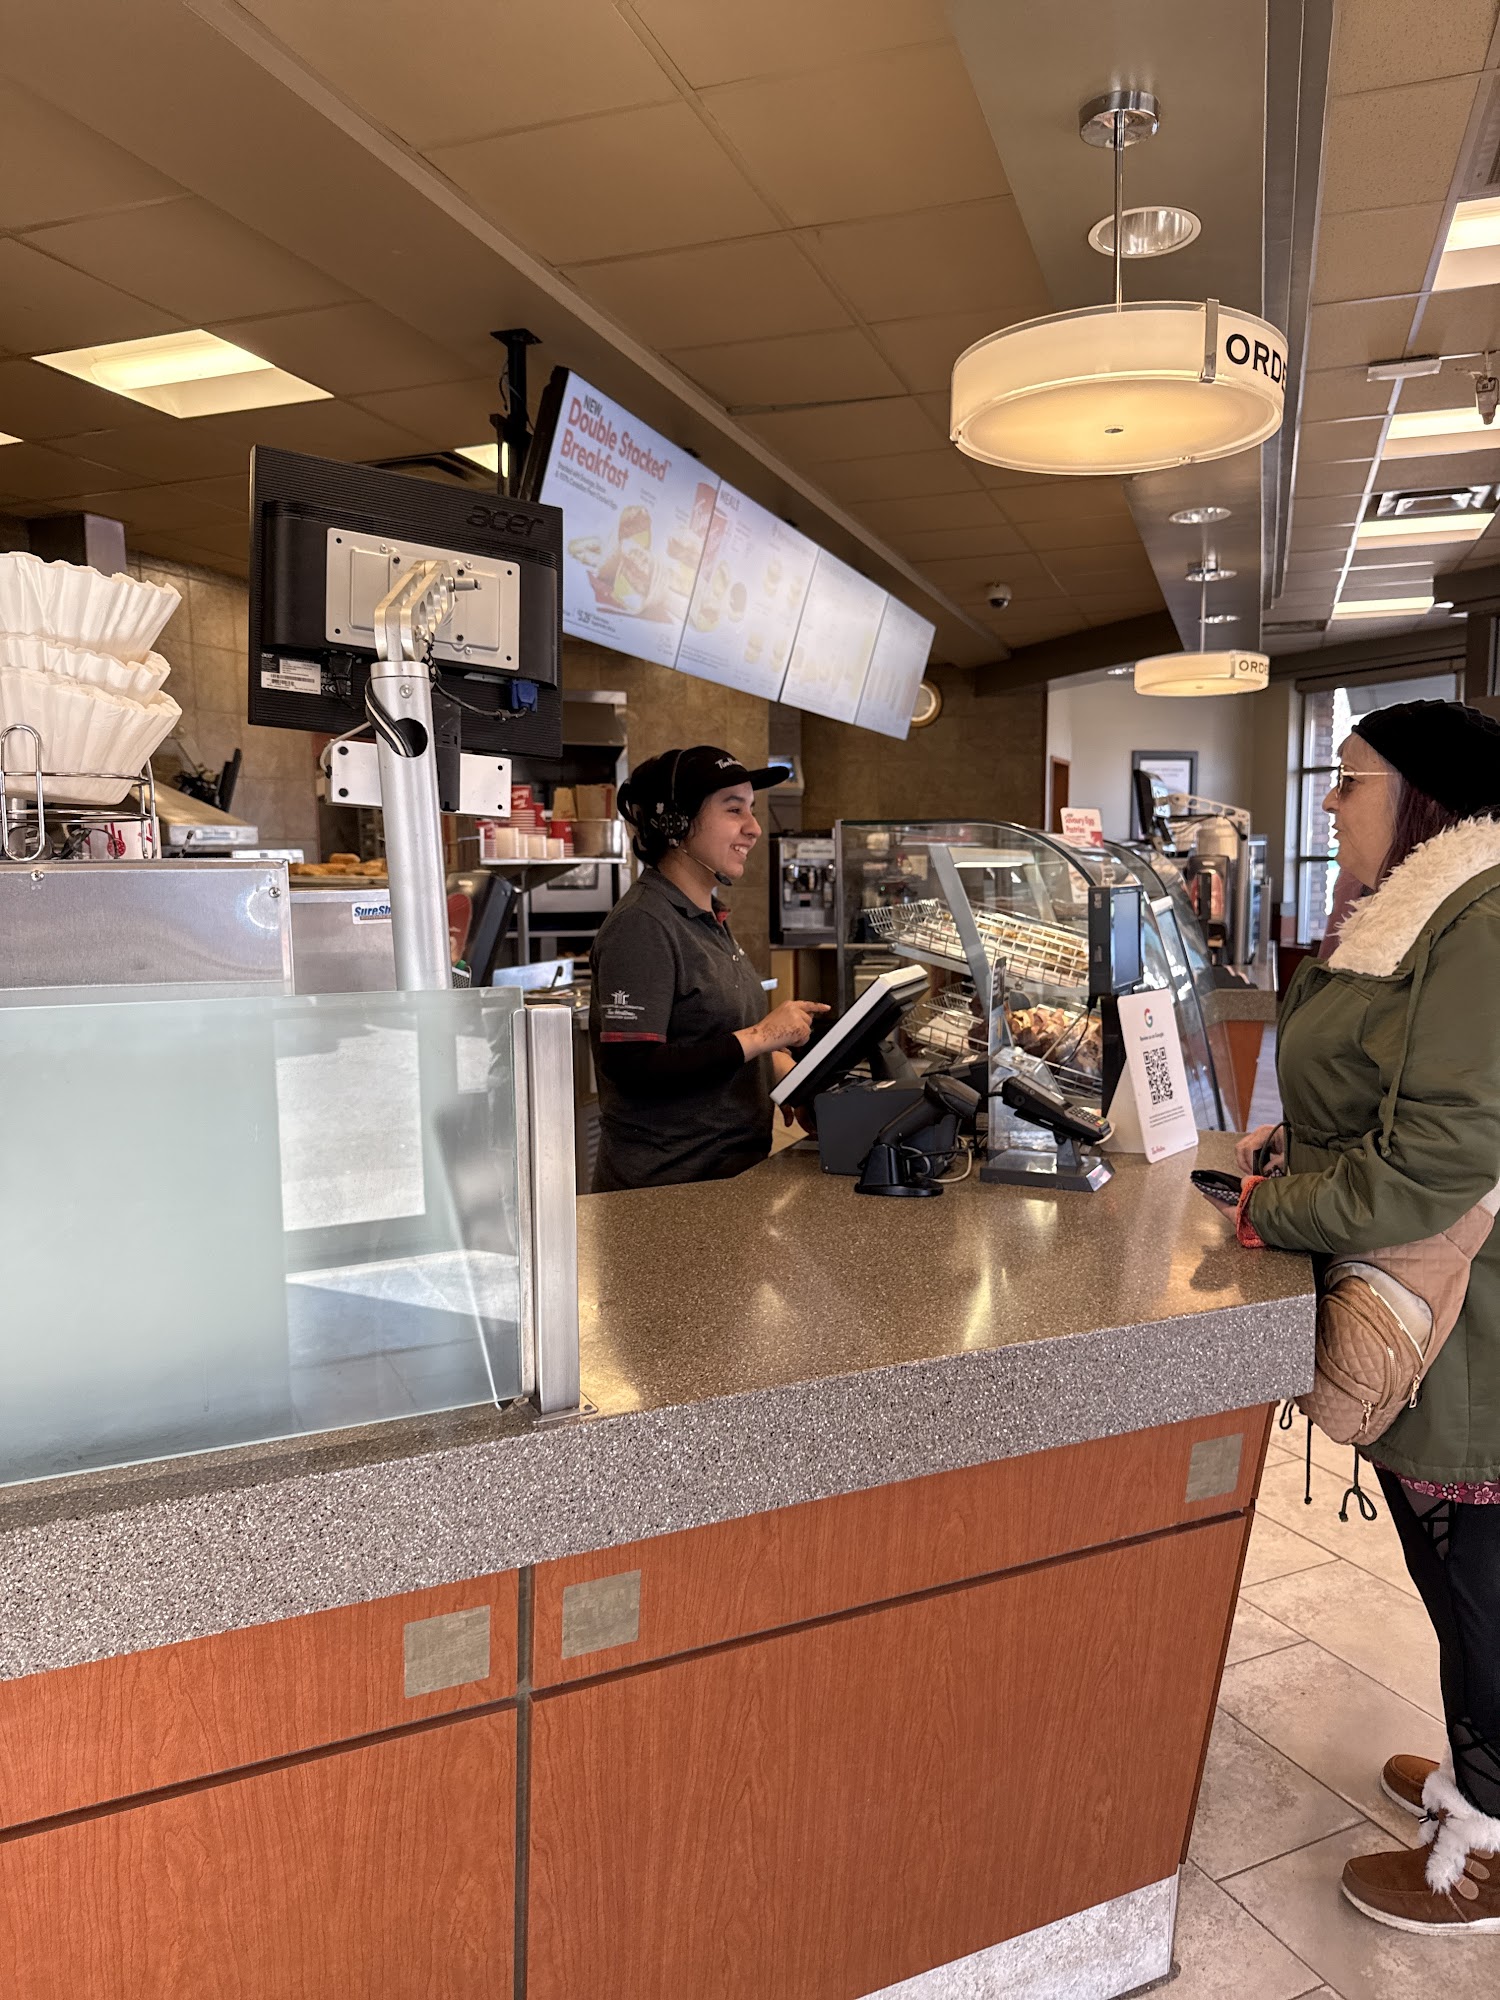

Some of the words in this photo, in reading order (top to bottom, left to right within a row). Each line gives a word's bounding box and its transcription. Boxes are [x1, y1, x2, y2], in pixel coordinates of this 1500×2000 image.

[583, 394, 602, 417] NEW
[560, 428, 628, 491] Breakfast
[568, 396, 617, 451] Double
[618, 431, 668, 482] Stacked
[466, 504, 544, 537] acer
